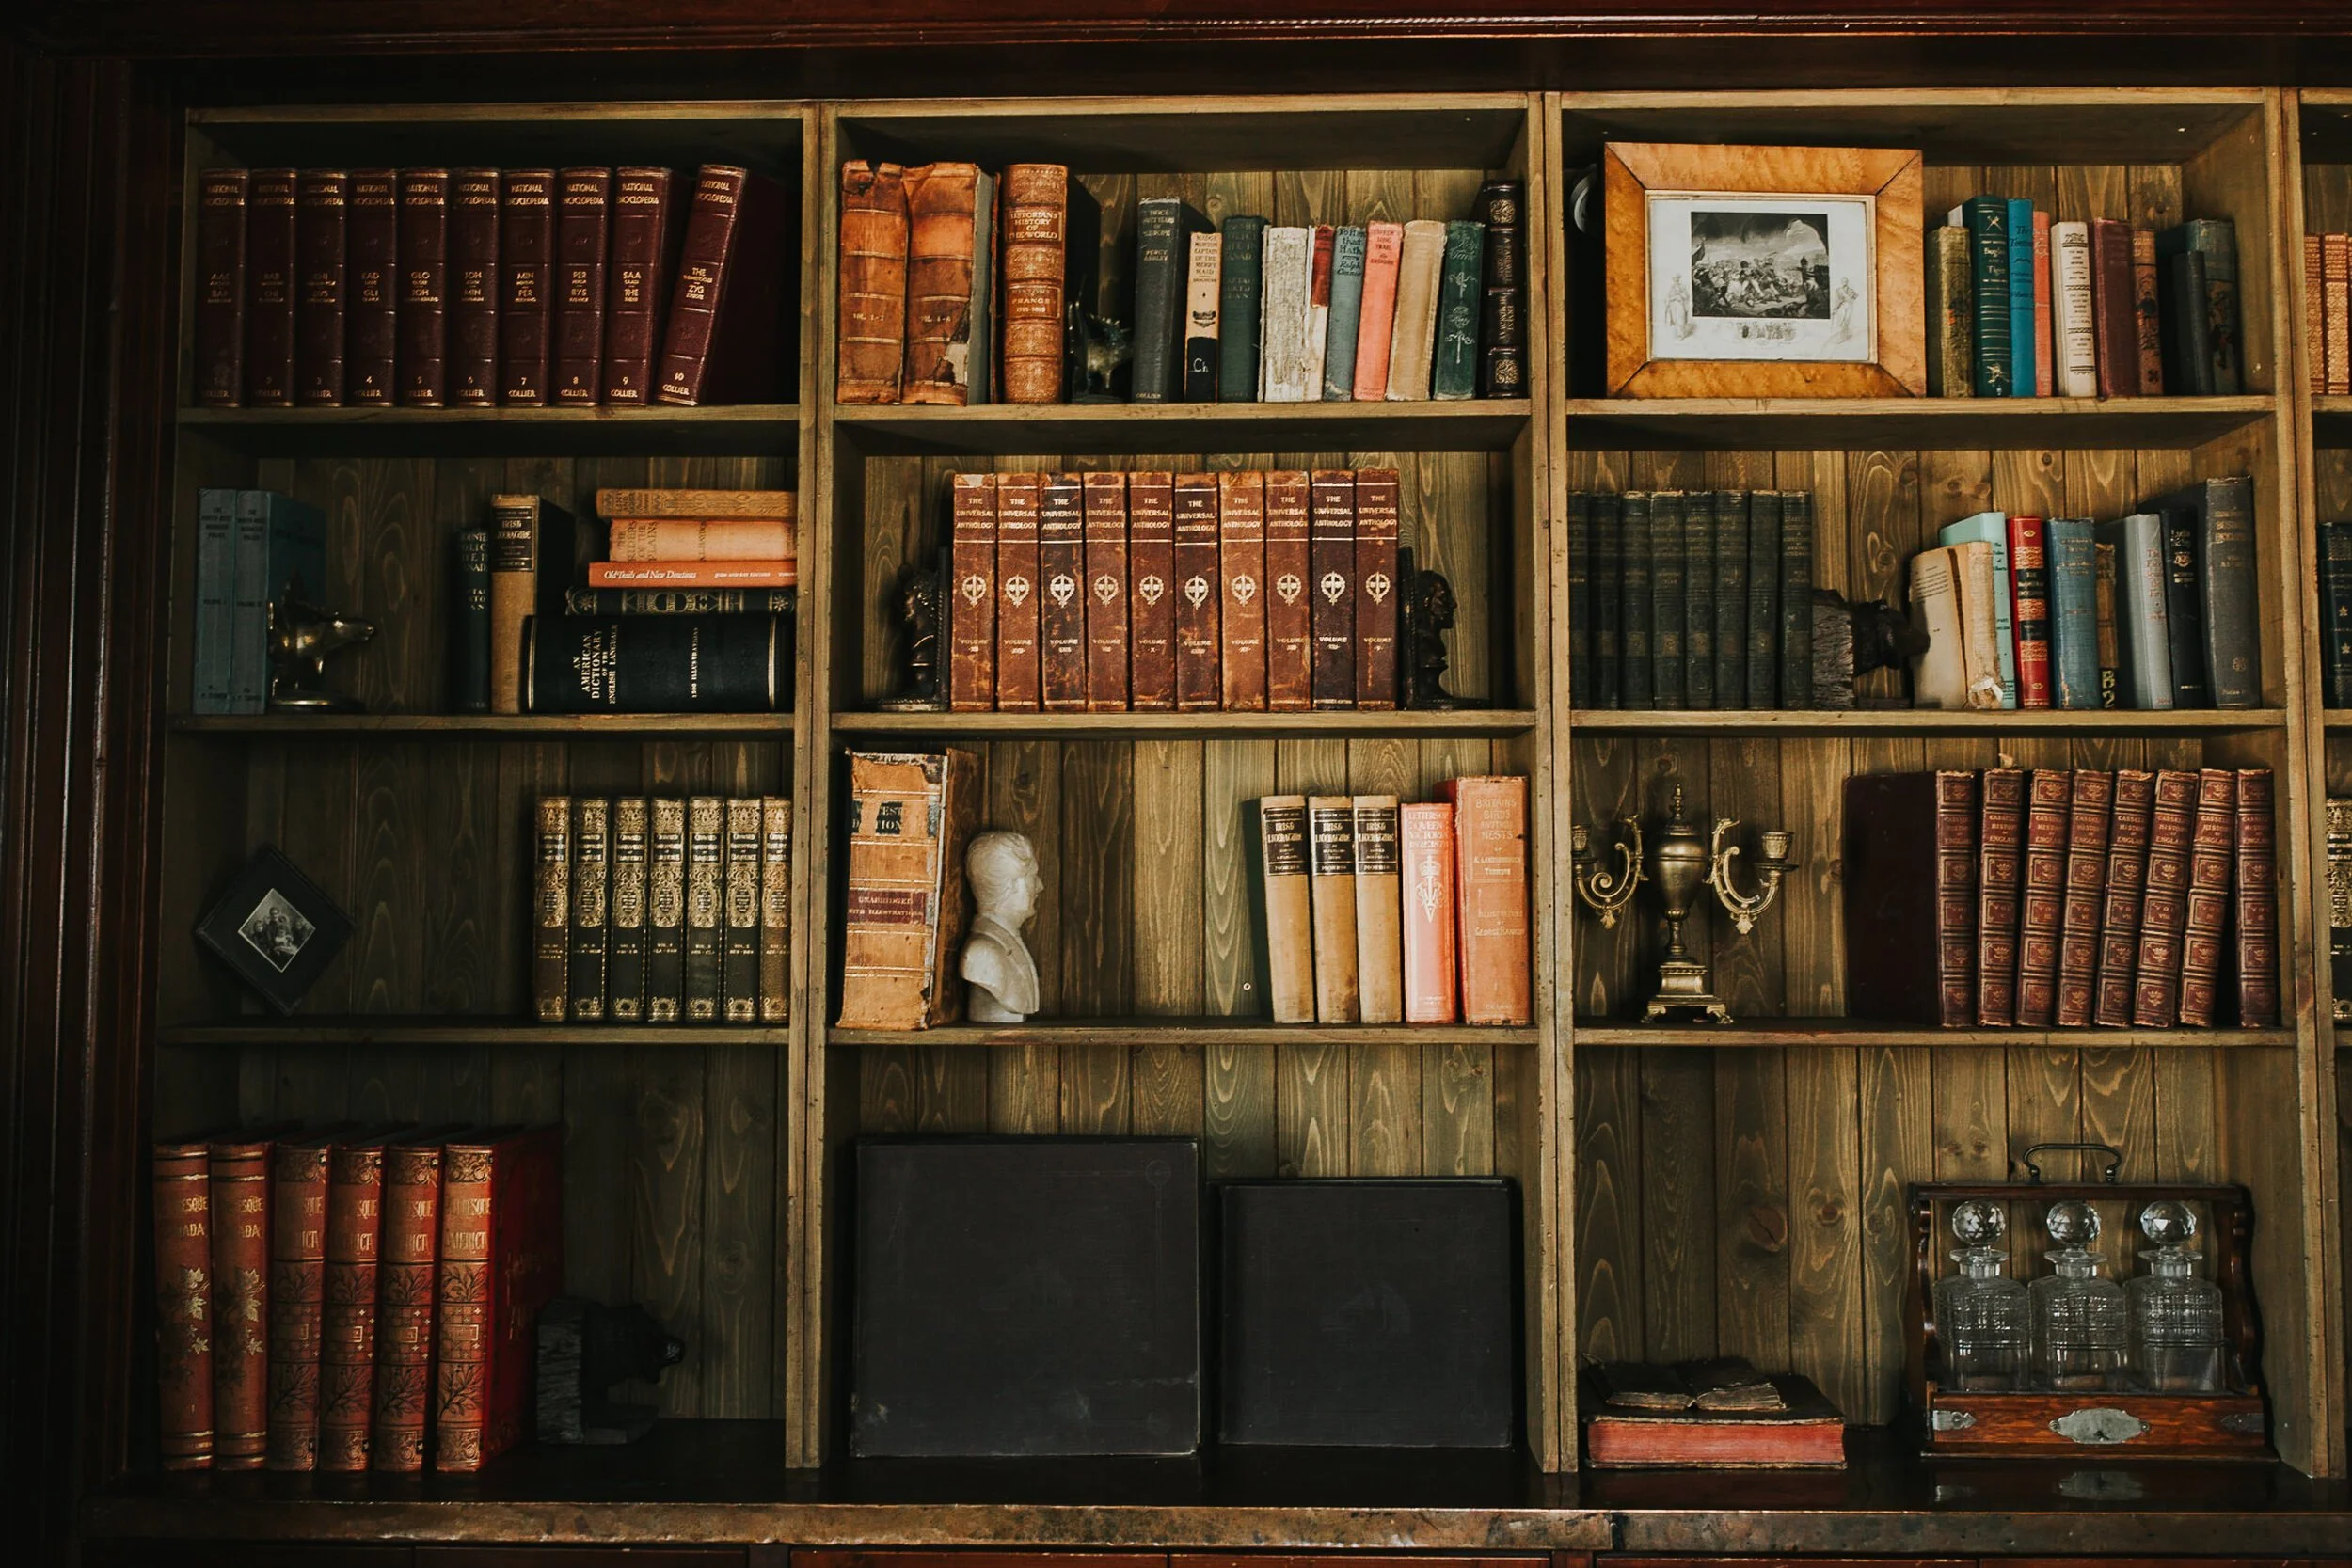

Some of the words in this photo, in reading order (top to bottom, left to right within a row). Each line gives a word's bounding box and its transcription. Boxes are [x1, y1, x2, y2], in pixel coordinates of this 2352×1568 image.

[457, 183, 489, 193] NATIONAL
[511, 183, 544, 193] NATIONAL
[566, 183, 599, 192] NATIONAL
[620, 182, 654, 192] NATIONAL
[700, 180, 731, 191] NATIONAL
[1343, 236, 1360, 245] that
[1340, 245, 1363, 254] Hath
[1340, 261, 1360, 271] Ralph
[1503, 245, 1513, 284] FAREWELL
[622, 271, 642, 280] SAA
[692, 267, 707, 277] THE
[624, 288, 640, 297] THE
[688, 285, 706, 295] ZYG
[1499, 295, 1508, 340] HEMINGWAY
[1193, 356, 1209, 372] Ch
[366, 375, 373, 384] 4
[520, 376, 527, 385] 7
[623, 376, 629, 385] 9
[674, 372, 685, 382] 10
[509, 388, 536, 397] COLLIER
[562, 388, 588, 397] COLLIER
[610, 388, 639, 397] COLLIER
[661, 385, 691, 396] COLLIER
[638, 525, 646, 541] THE
[616, 531, 625, 549] THE
[627, 520, 637, 562] RIDERS
[647, 521, 658, 562] PLAINS
[638, 549, 645, 558] OF
[604, 570, 618, 579] Old
[636, 570, 649, 579] and
[649, 570, 666, 579] New
[608, 624, 619, 665] LANGUAGE
[573, 657, 580, 669] AN
[581, 634, 591, 692] AMERICAN
[591, 628, 602, 699] DICTIONARY
[602, 668, 609, 677] OF
[2102, 672, 2116, 689] B
[608, 670, 617, 704] ENGLISH
[2102, 691, 2116, 708] 2
[1484, 810, 1511, 819] BIRDS
[1275, 822, 1295, 832] IRISH
[1322, 822, 1343, 832] IRISH
[1366, 822, 1386, 832] IRISH
[1482, 831, 1513, 840] NESTS
